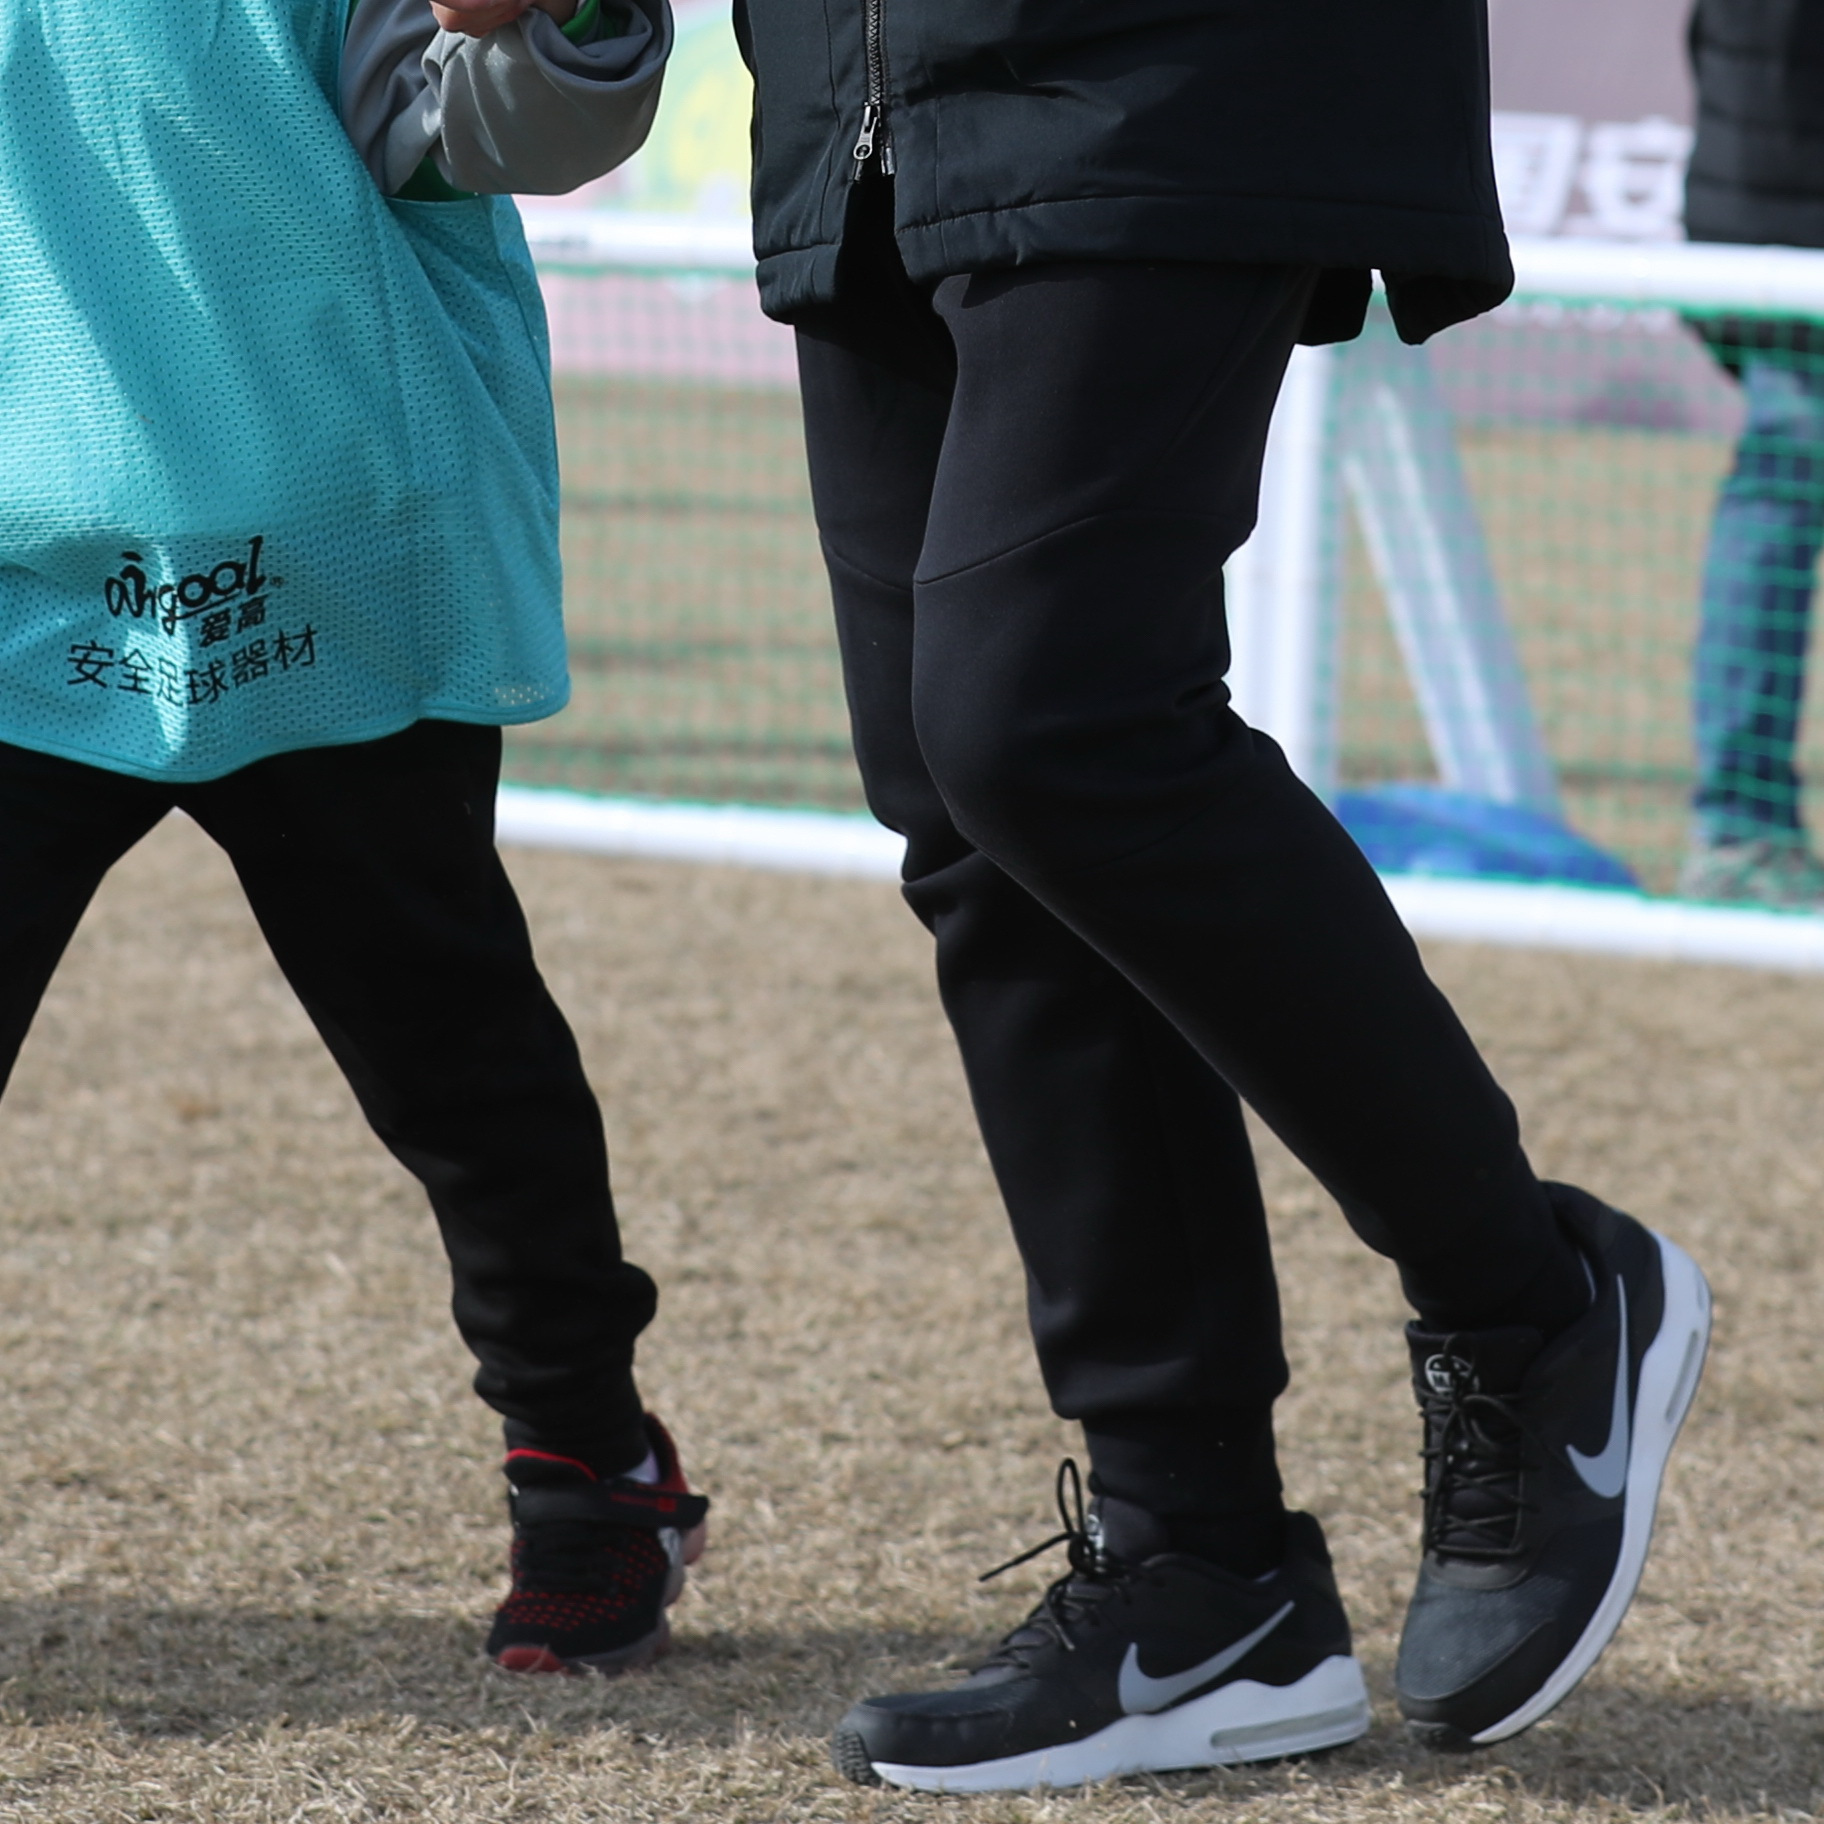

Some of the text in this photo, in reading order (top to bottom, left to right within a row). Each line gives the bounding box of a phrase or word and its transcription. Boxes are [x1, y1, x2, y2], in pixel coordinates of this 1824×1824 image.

[199, 594, 269, 647] 爱高
[67, 624, 318, 706] 安全足球器材
